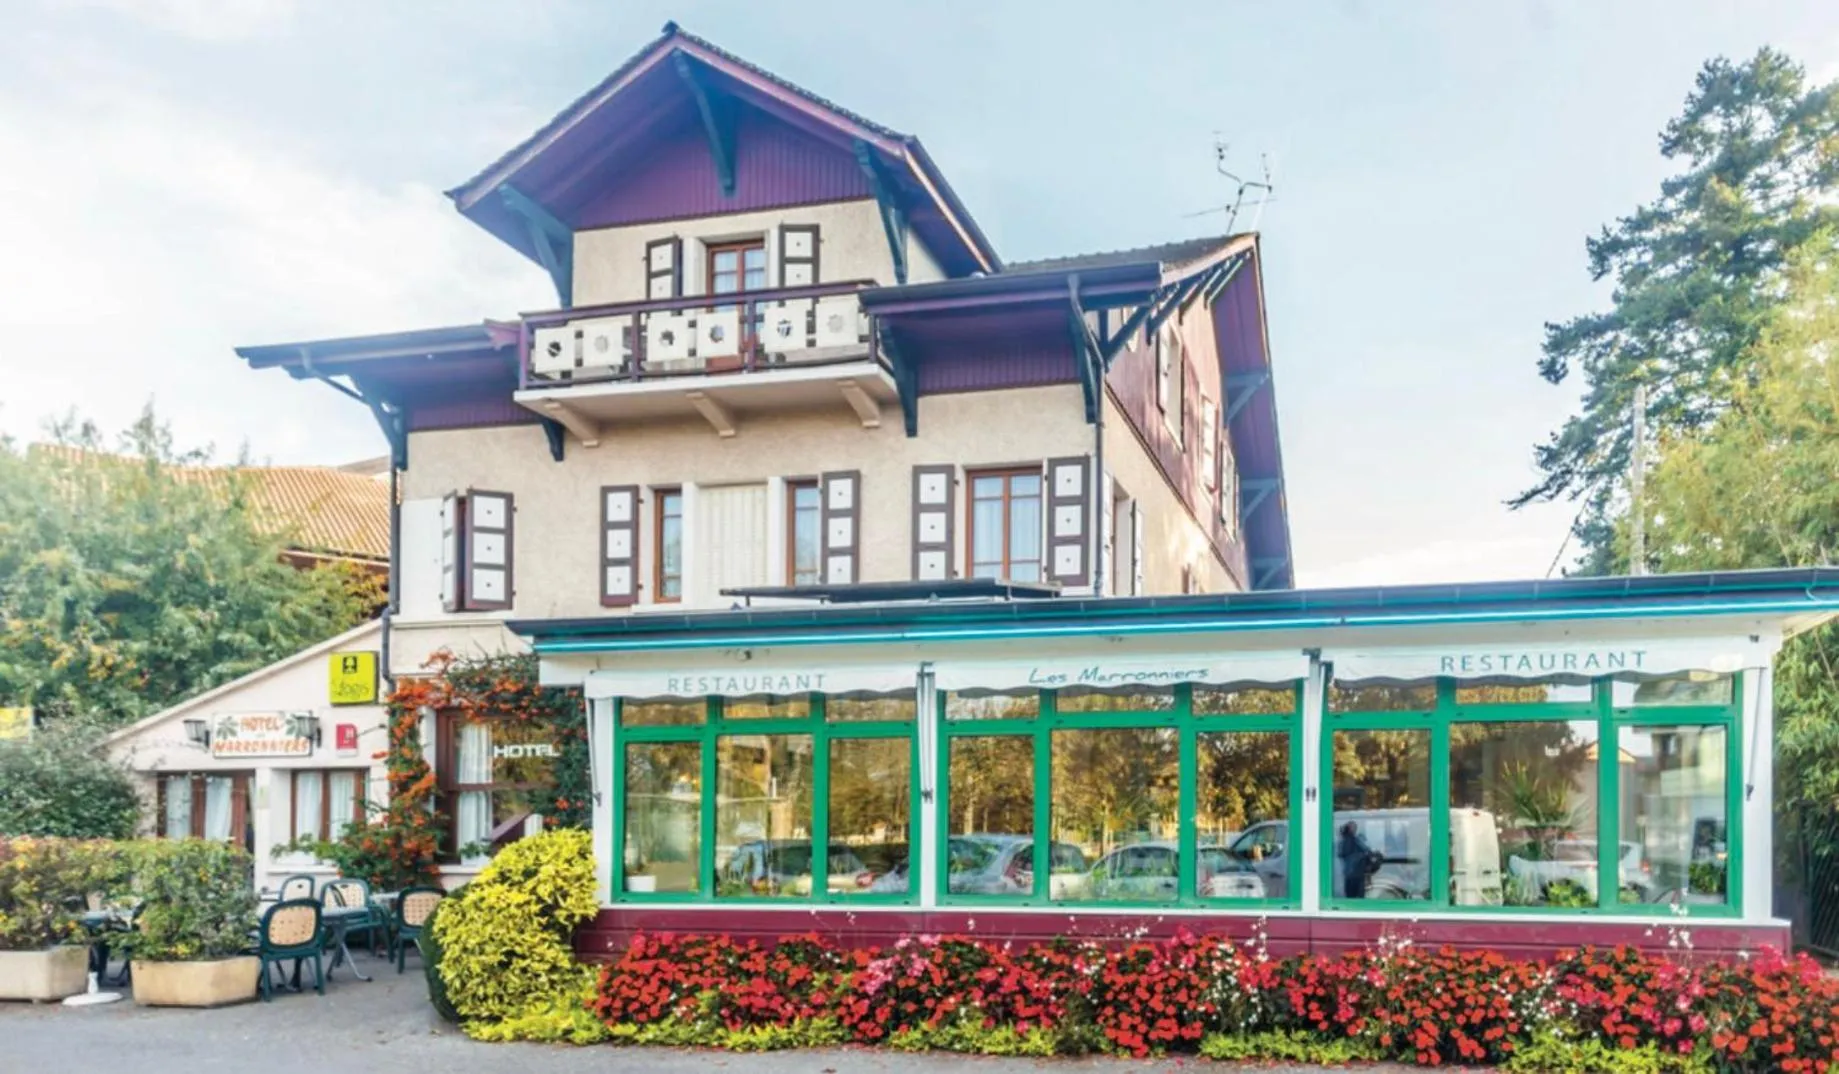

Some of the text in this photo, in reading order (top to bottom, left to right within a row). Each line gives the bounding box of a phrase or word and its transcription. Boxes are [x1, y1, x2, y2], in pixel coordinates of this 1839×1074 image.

[1440, 651, 1647, 672] RESTAURANT
[667, 674, 827, 692] RESTAURANT
[1028, 666, 1210, 684] Les Marronniers
[493, 743, 561, 758] HOTEL
